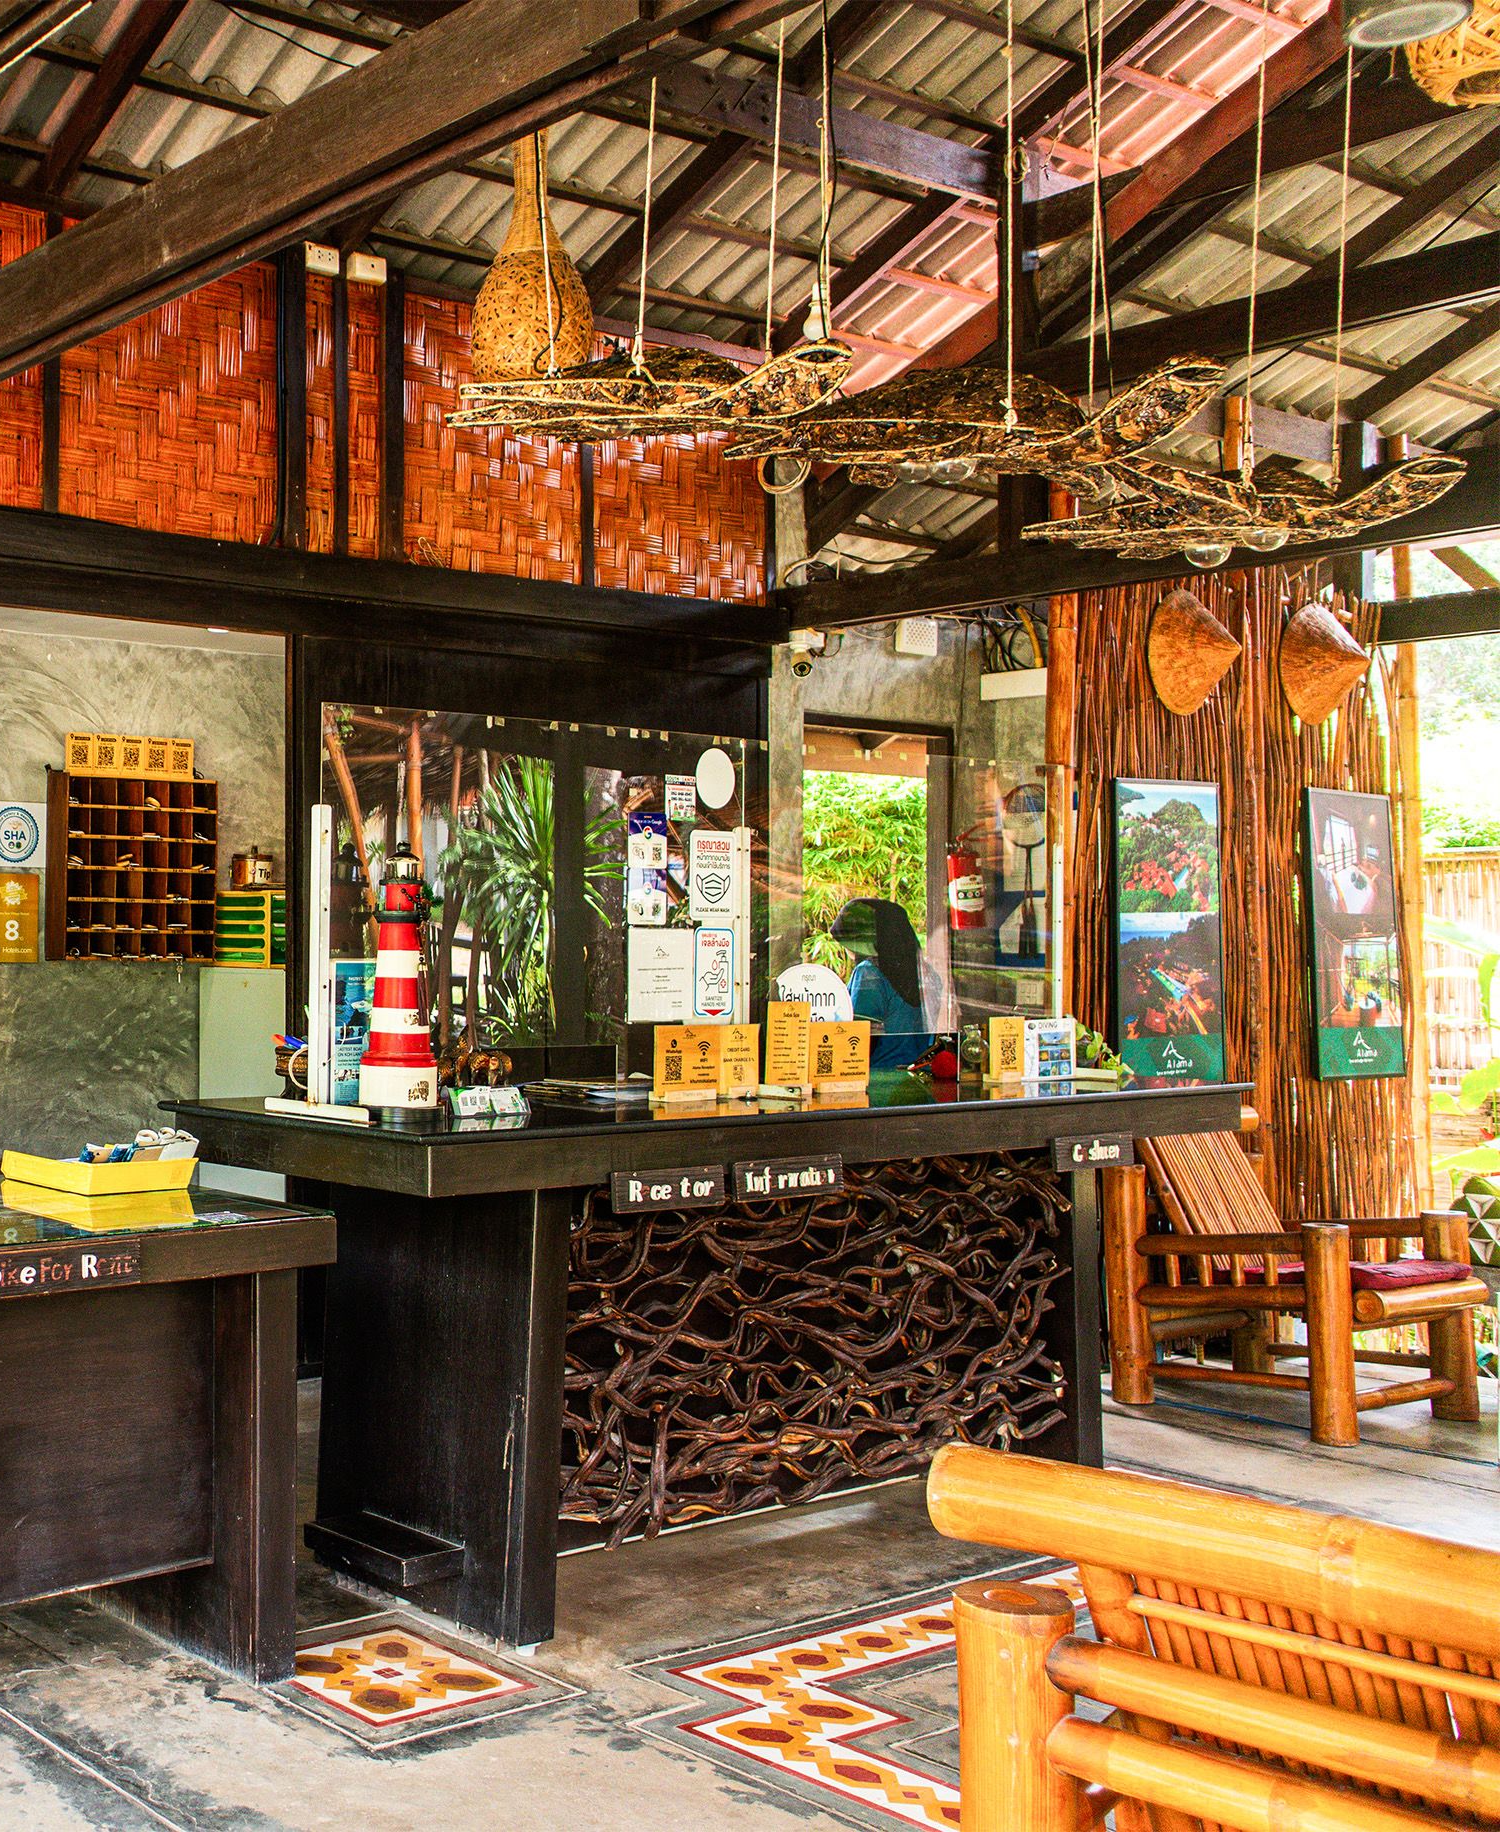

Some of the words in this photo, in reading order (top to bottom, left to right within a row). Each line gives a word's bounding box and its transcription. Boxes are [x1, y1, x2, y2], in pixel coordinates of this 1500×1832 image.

[3, 831, 27, 841] SHA
[5, 919, 20, 941] 8
[2, 946, 33, 954] Hotels.com
[1166, 1058, 1193, 1069] Alama
